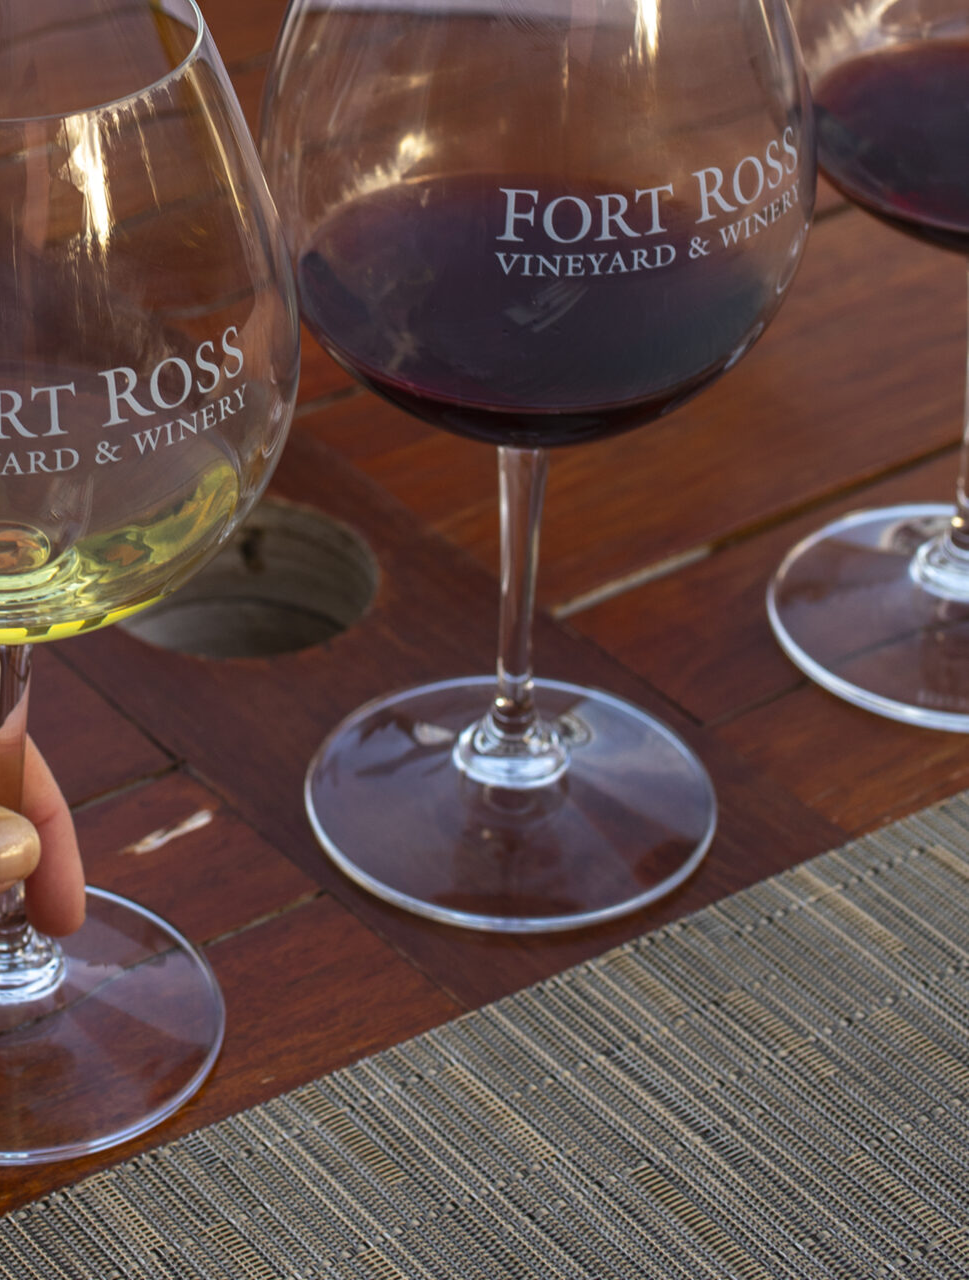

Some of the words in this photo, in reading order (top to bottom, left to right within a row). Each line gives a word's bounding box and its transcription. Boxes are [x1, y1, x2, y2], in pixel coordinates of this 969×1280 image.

[494, 243, 677, 278] VINEYARD
[687, 235, 711, 260] &
[718, 178, 801, 250] WINERY
[495, 182, 675, 244] FORT
[691, 125, 799, 225] ROSS
[94, 440, 123, 465] &
[131, 383, 248, 456] WINERY
[97, 325, 245, 428] ROSS
